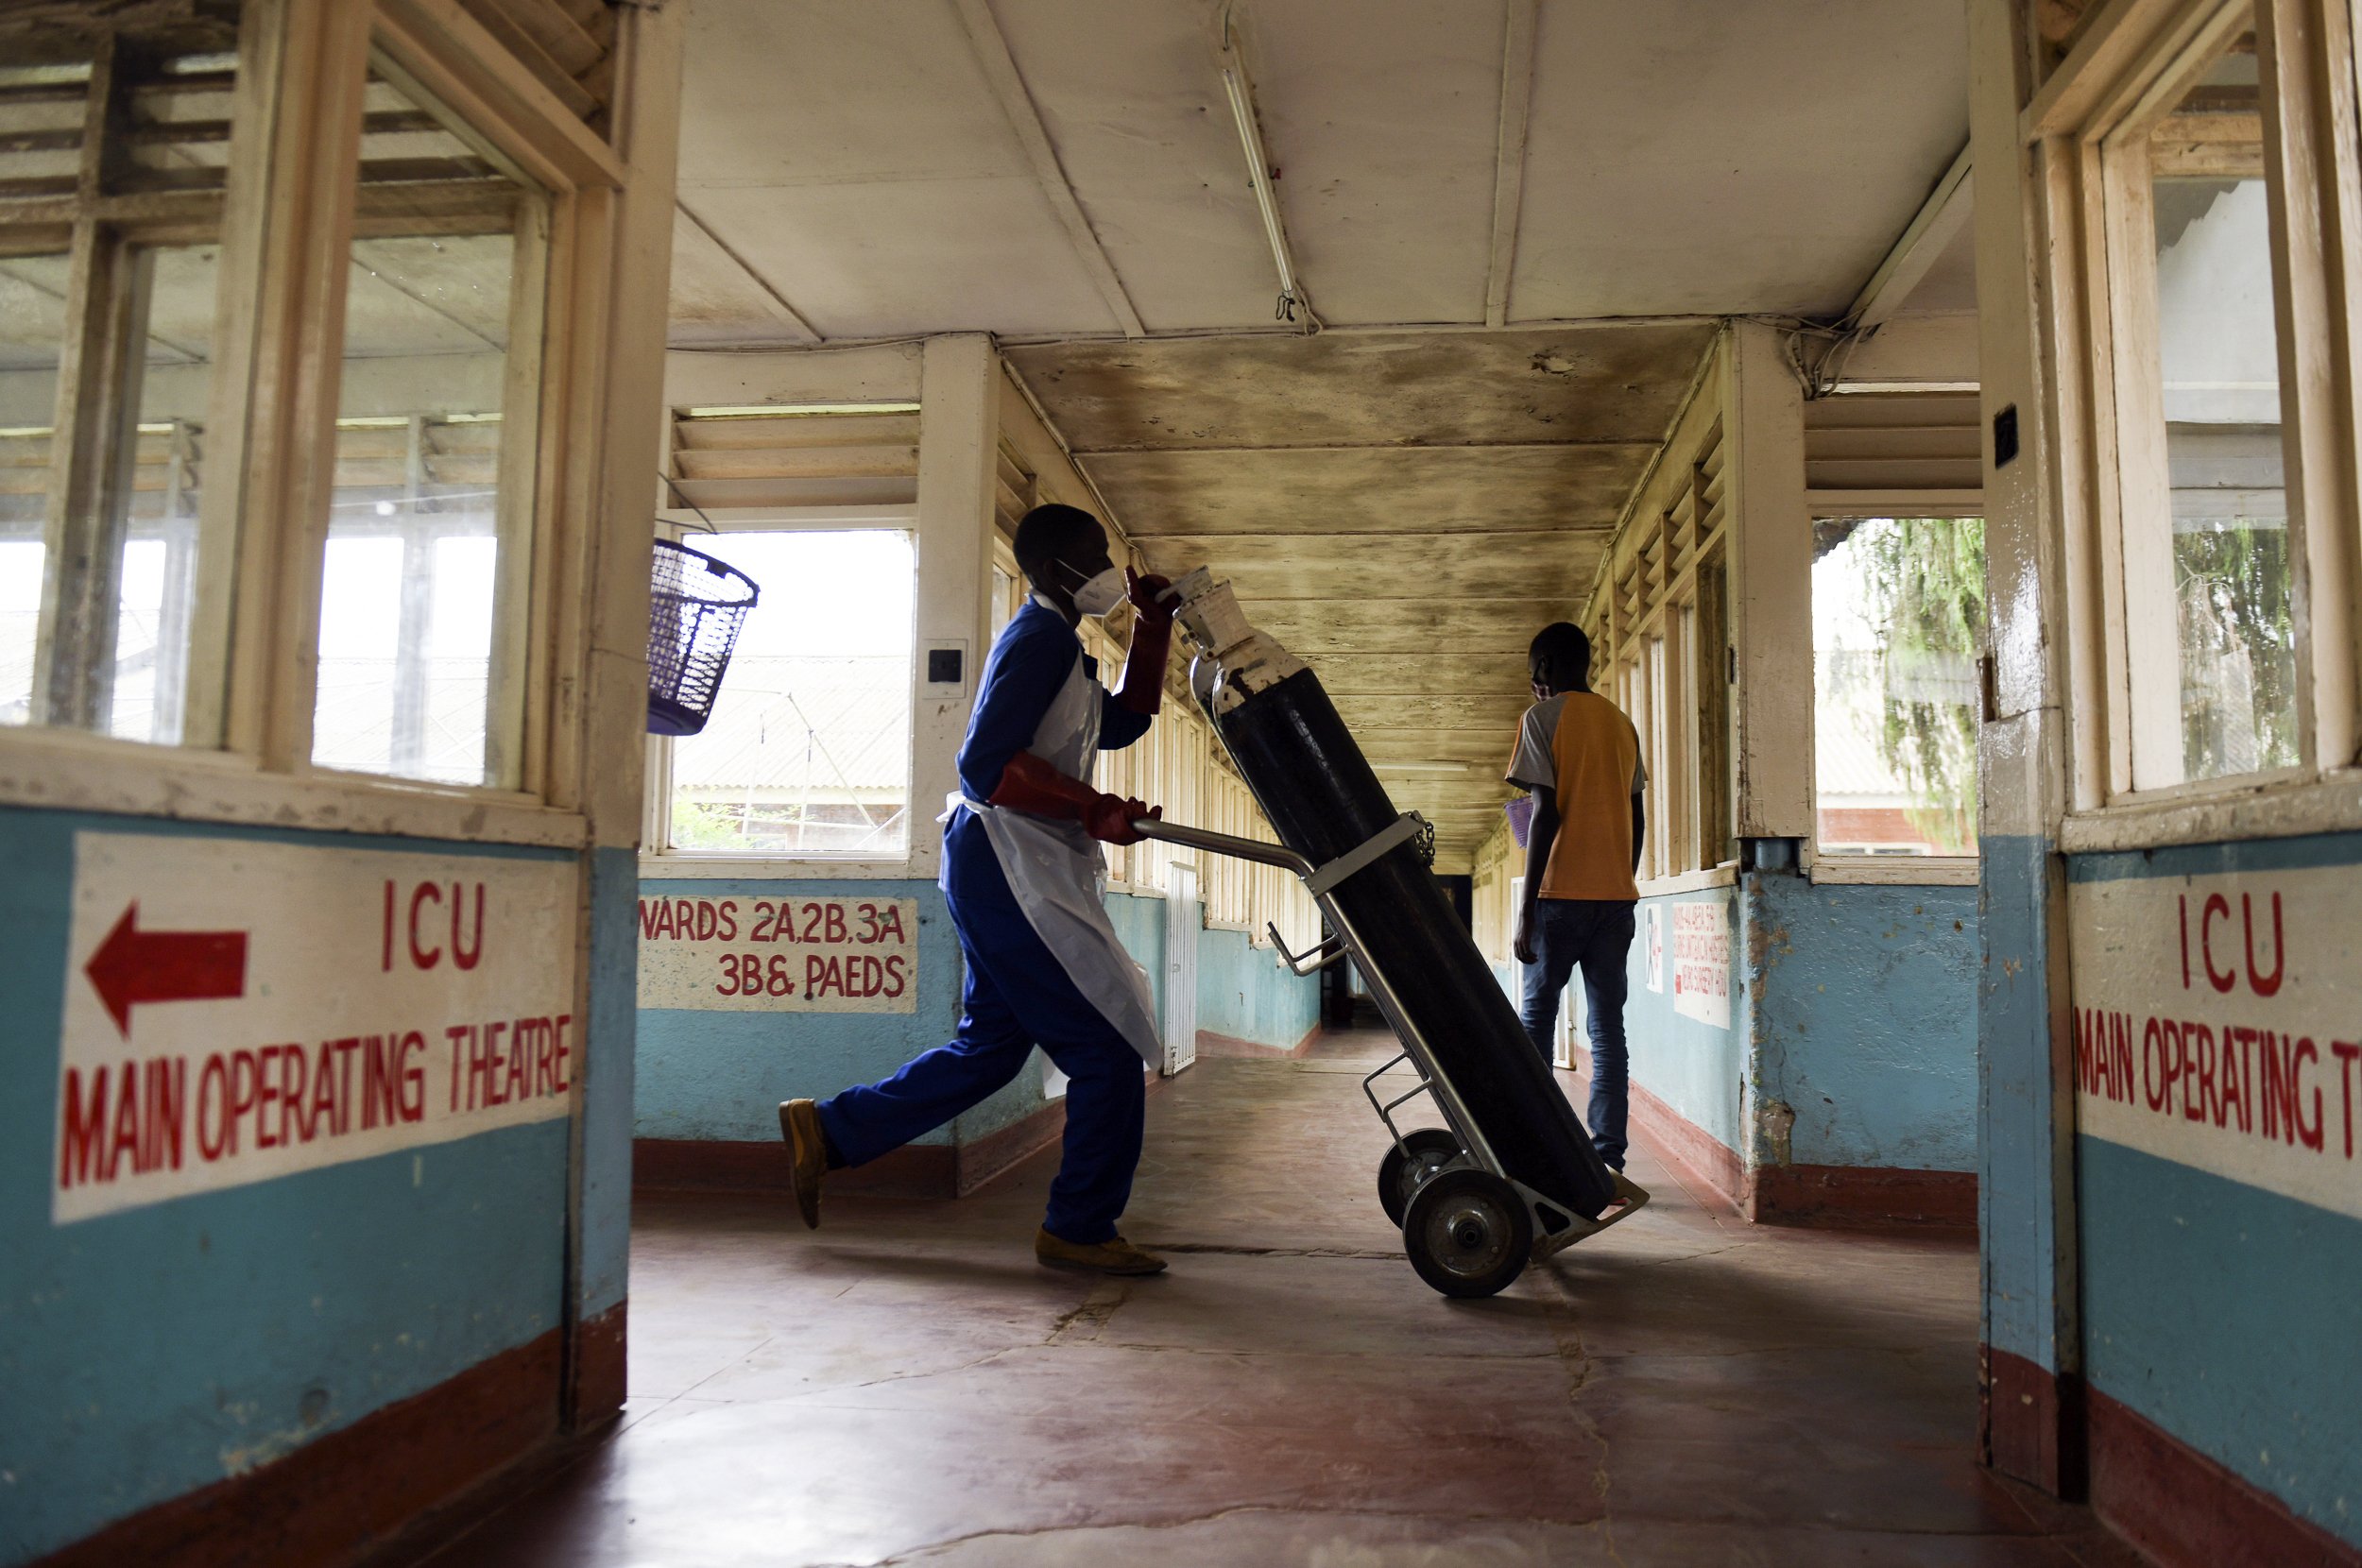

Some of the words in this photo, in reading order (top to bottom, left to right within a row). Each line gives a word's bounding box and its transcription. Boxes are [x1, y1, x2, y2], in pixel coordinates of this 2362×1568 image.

[382, 879, 486, 972] ICU
[806, 954, 906, 999] PAEDS
[2178, 891, 2285, 997] ICU
[60, 1055, 186, 1190] MAIN
[197, 1030, 426, 1163] OPERATING
[445, 1014, 573, 1113] THEATRE
[2073, 1006, 2135, 1106] MAIN
[2143, 1016, 2324, 1153] OPERATING
